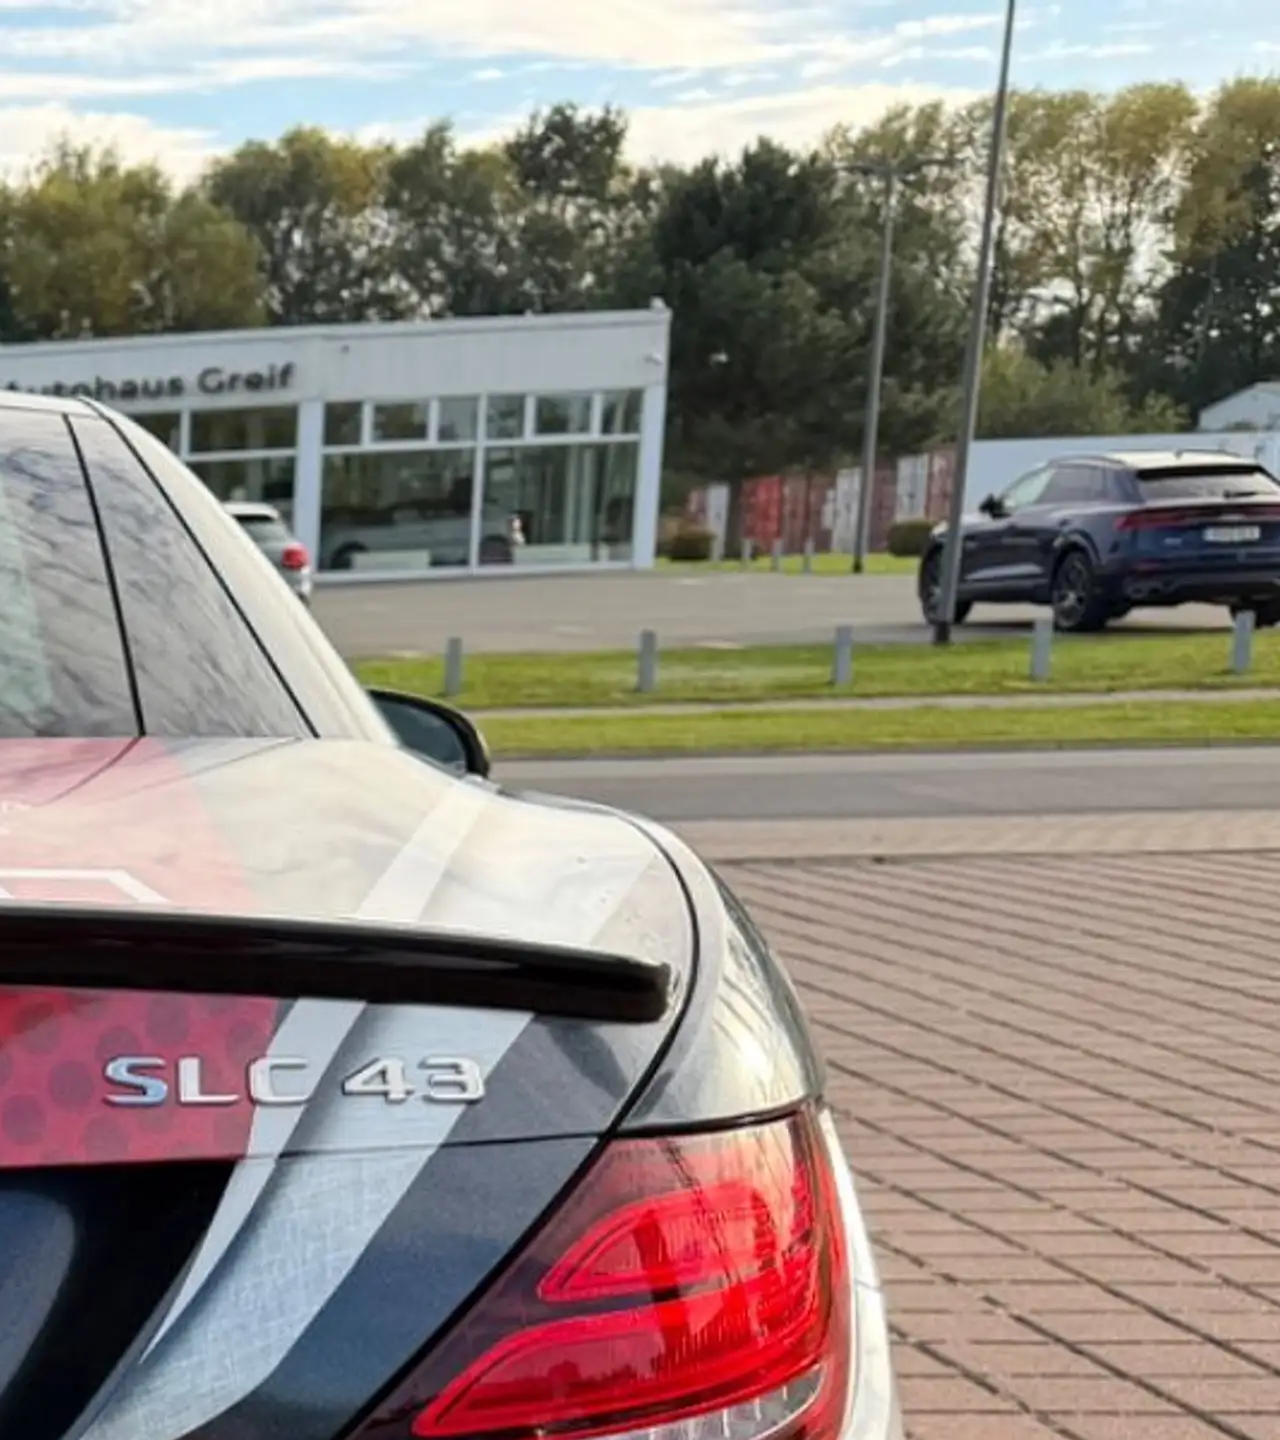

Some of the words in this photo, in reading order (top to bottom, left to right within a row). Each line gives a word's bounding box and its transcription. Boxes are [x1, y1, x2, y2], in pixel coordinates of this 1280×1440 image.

[197, 362, 295, 394] Greif
[104, 1056, 311, 1105] SLC
[343, 1055, 485, 1104] 43
